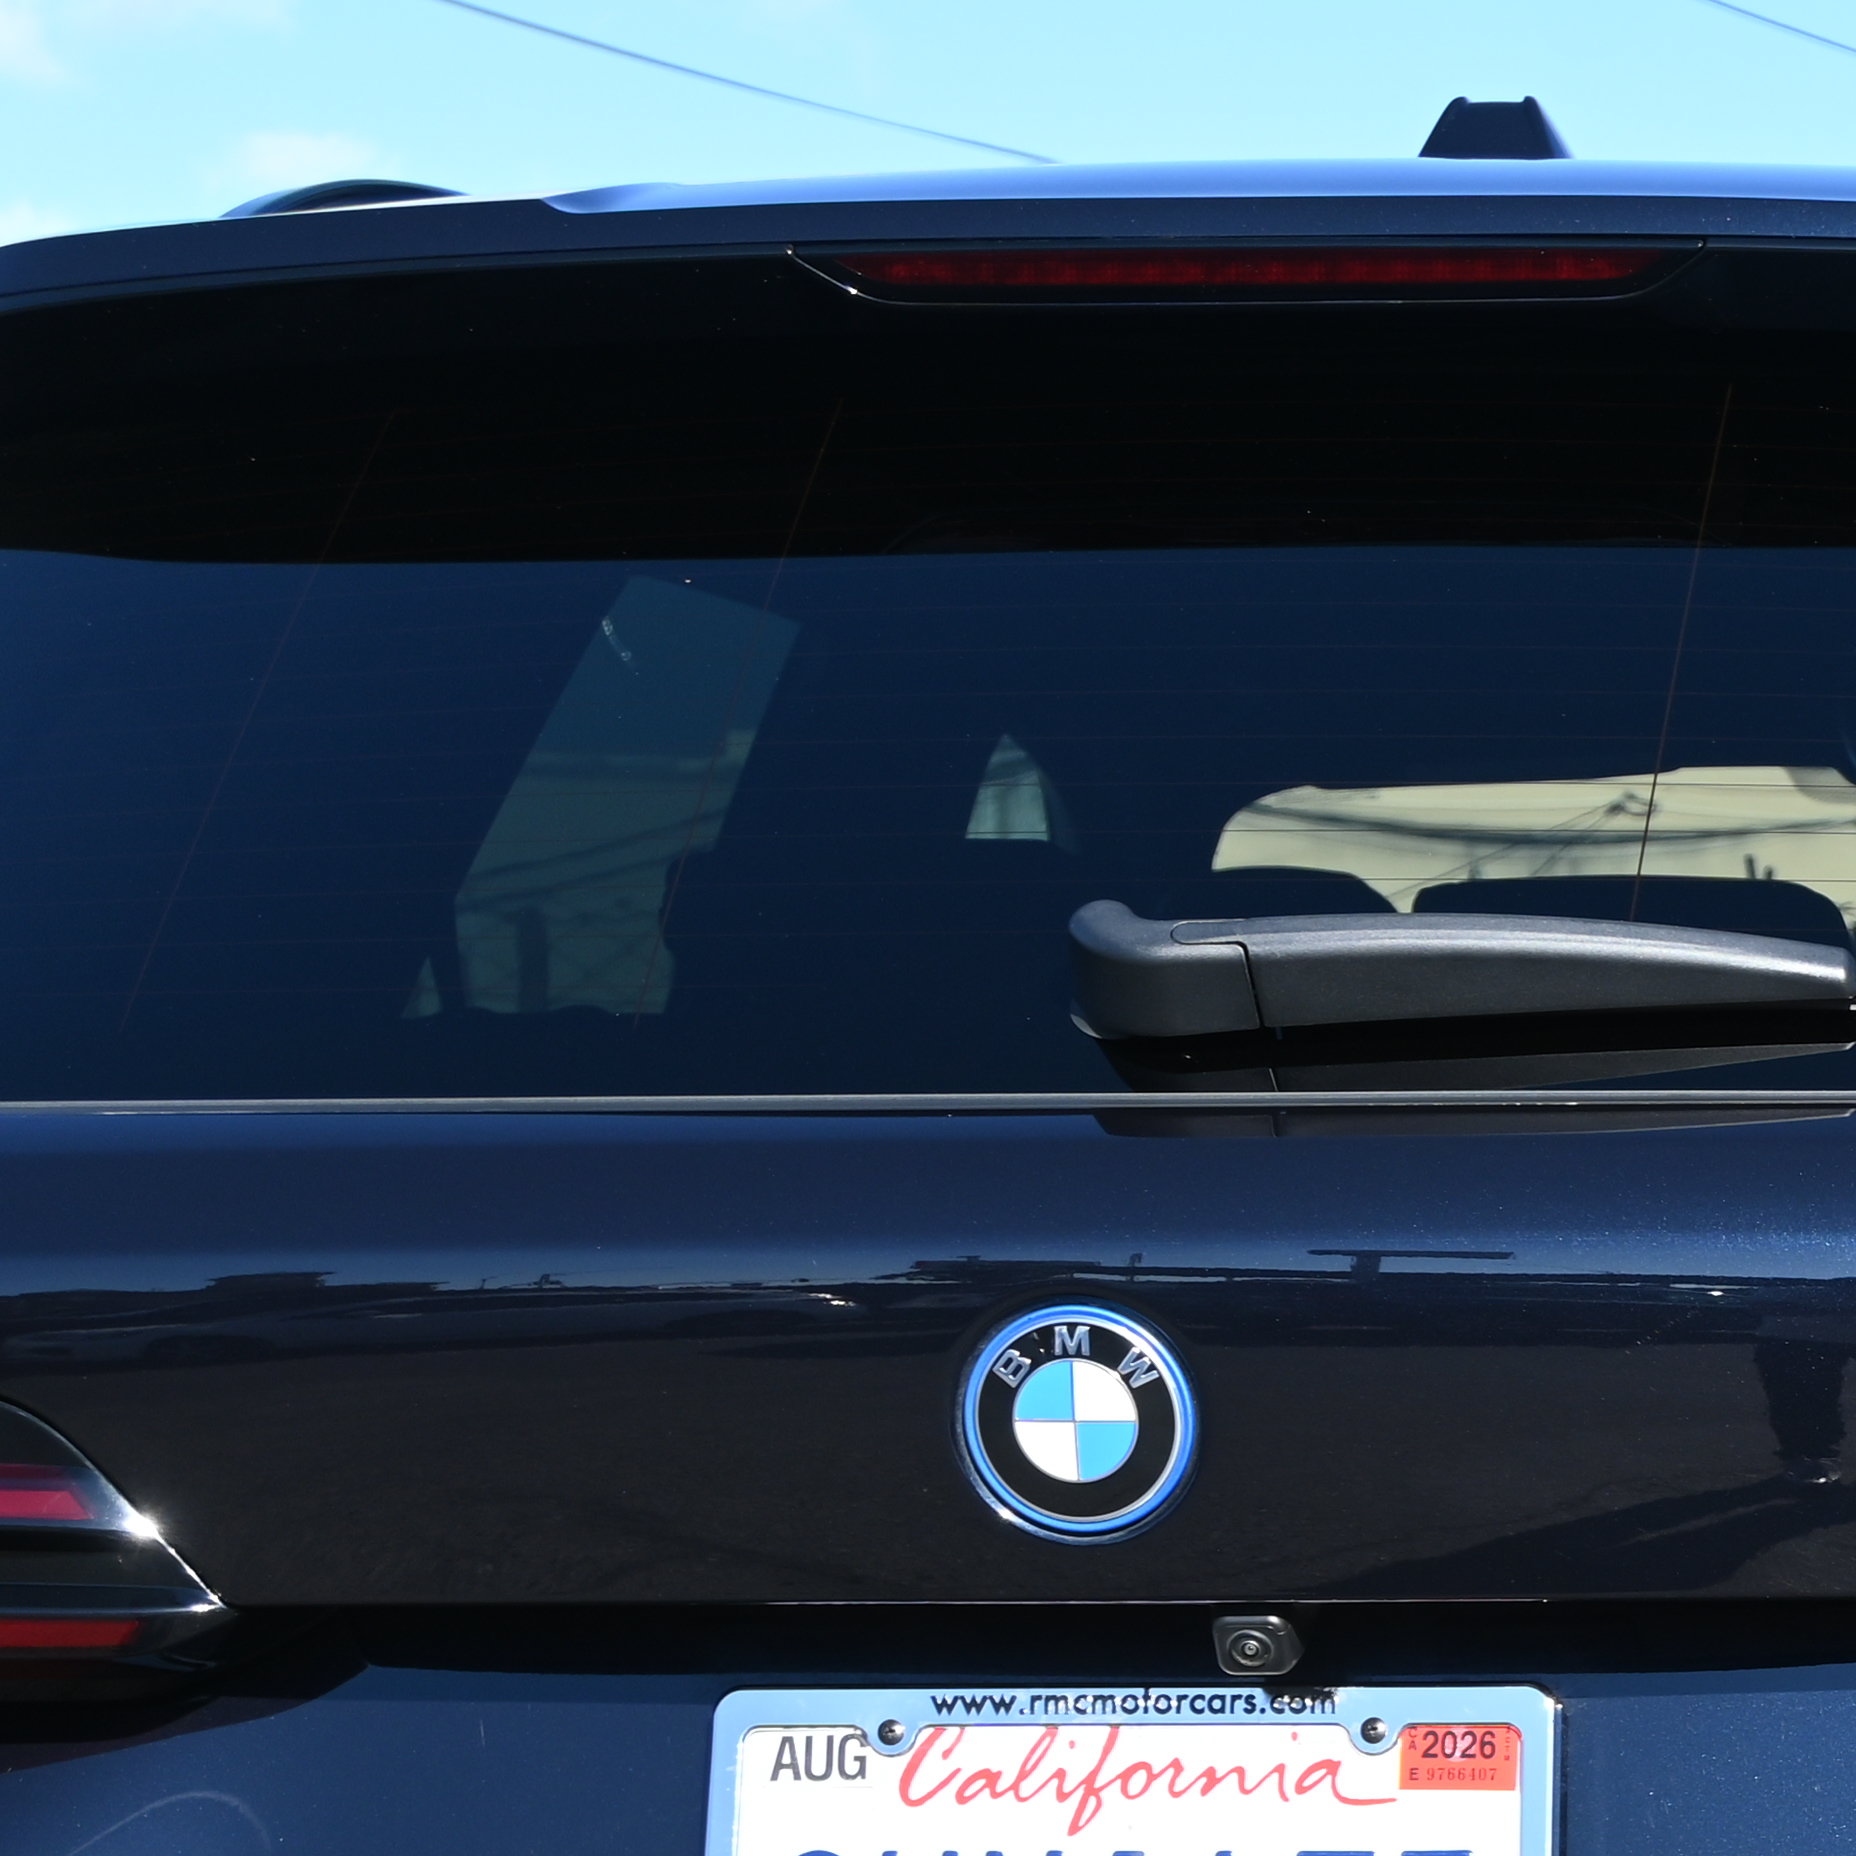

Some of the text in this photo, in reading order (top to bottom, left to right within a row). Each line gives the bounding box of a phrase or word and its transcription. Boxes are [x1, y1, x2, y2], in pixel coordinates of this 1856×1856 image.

[992, 1325, 1159, 1389] BMW
[930, 1688, 1338, 1718] www.rmcmotorcars.com
[769, 1732, 869, 1783] AUG
[1421, 1730, 1497, 1760] 2026
[896, 1725, 1397, 1836] California
